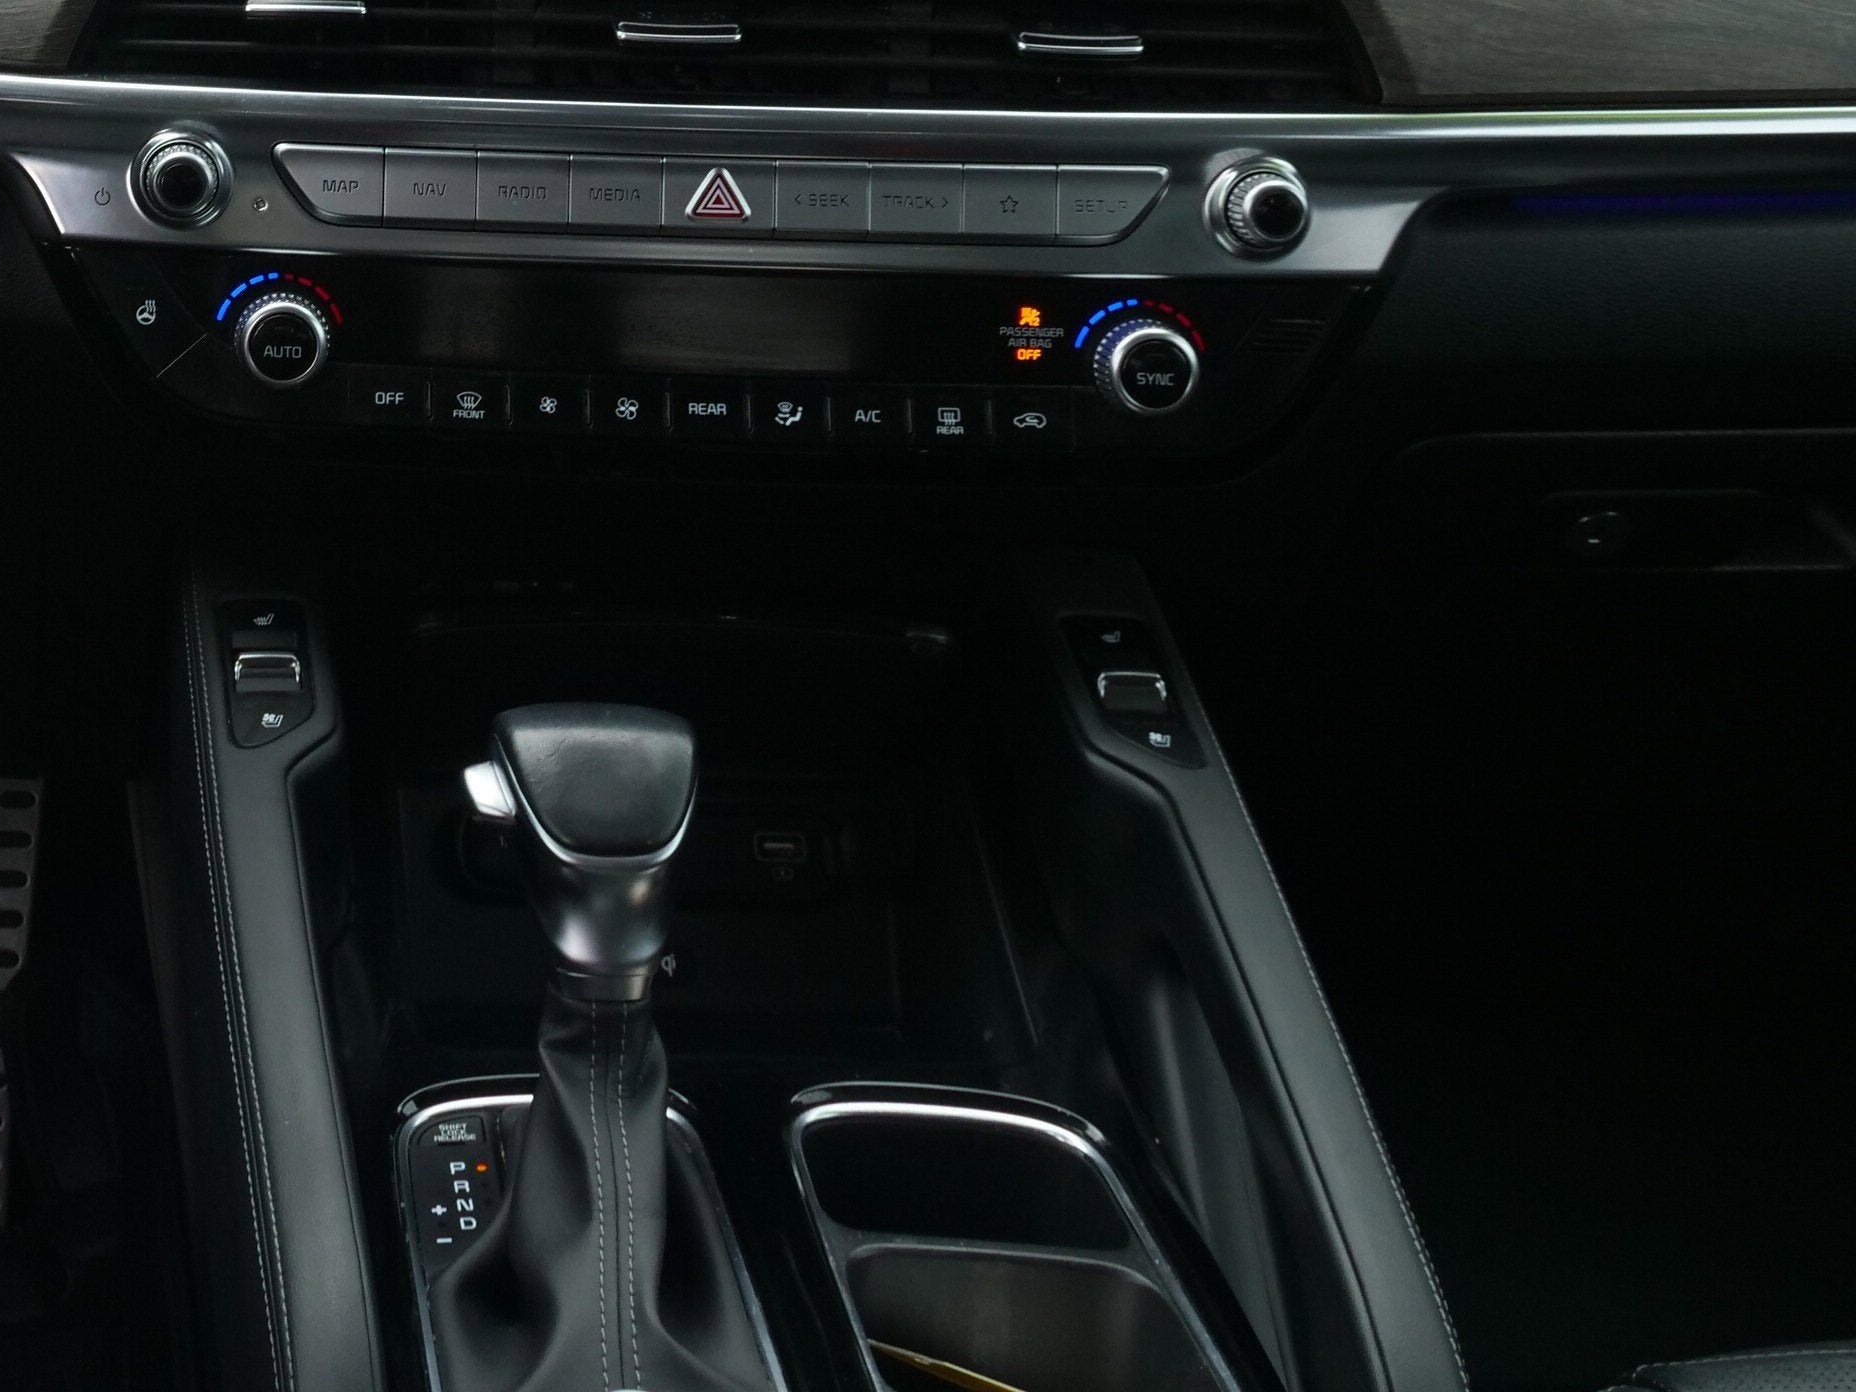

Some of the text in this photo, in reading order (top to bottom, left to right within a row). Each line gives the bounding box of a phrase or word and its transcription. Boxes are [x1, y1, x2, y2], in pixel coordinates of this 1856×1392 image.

[323, 179, 359, 195] MAP
[413, 181, 446, 198] NAV
[498, 185, 547, 200] RADIO
[589, 187, 641, 202] MEDIA
[808, 193, 850, 207] SEEK
[882, 195, 935, 209] TRACK
[999, 326, 1065, 338] PASSENGER
[1008, 338, 1053, 349] AIR BAG
[264, 344, 302, 360] AUTO
[1017, 348, 1042, 361] OFF
[1137, 371, 1174, 387] SYNC
[375, 391, 404, 406] OFF
[453, 408, 485, 420] FRONT
[689, 402, 727, 417] REAR
[855, 408, 881, 423] A/C
[936, 423, 964, 436] REAR
[450, 1161, 466, 1175] P
[454, 1179, 470, 1193] R
[456, 1198, 474, 1212] N
[460, 1216, 477, 1230] D
